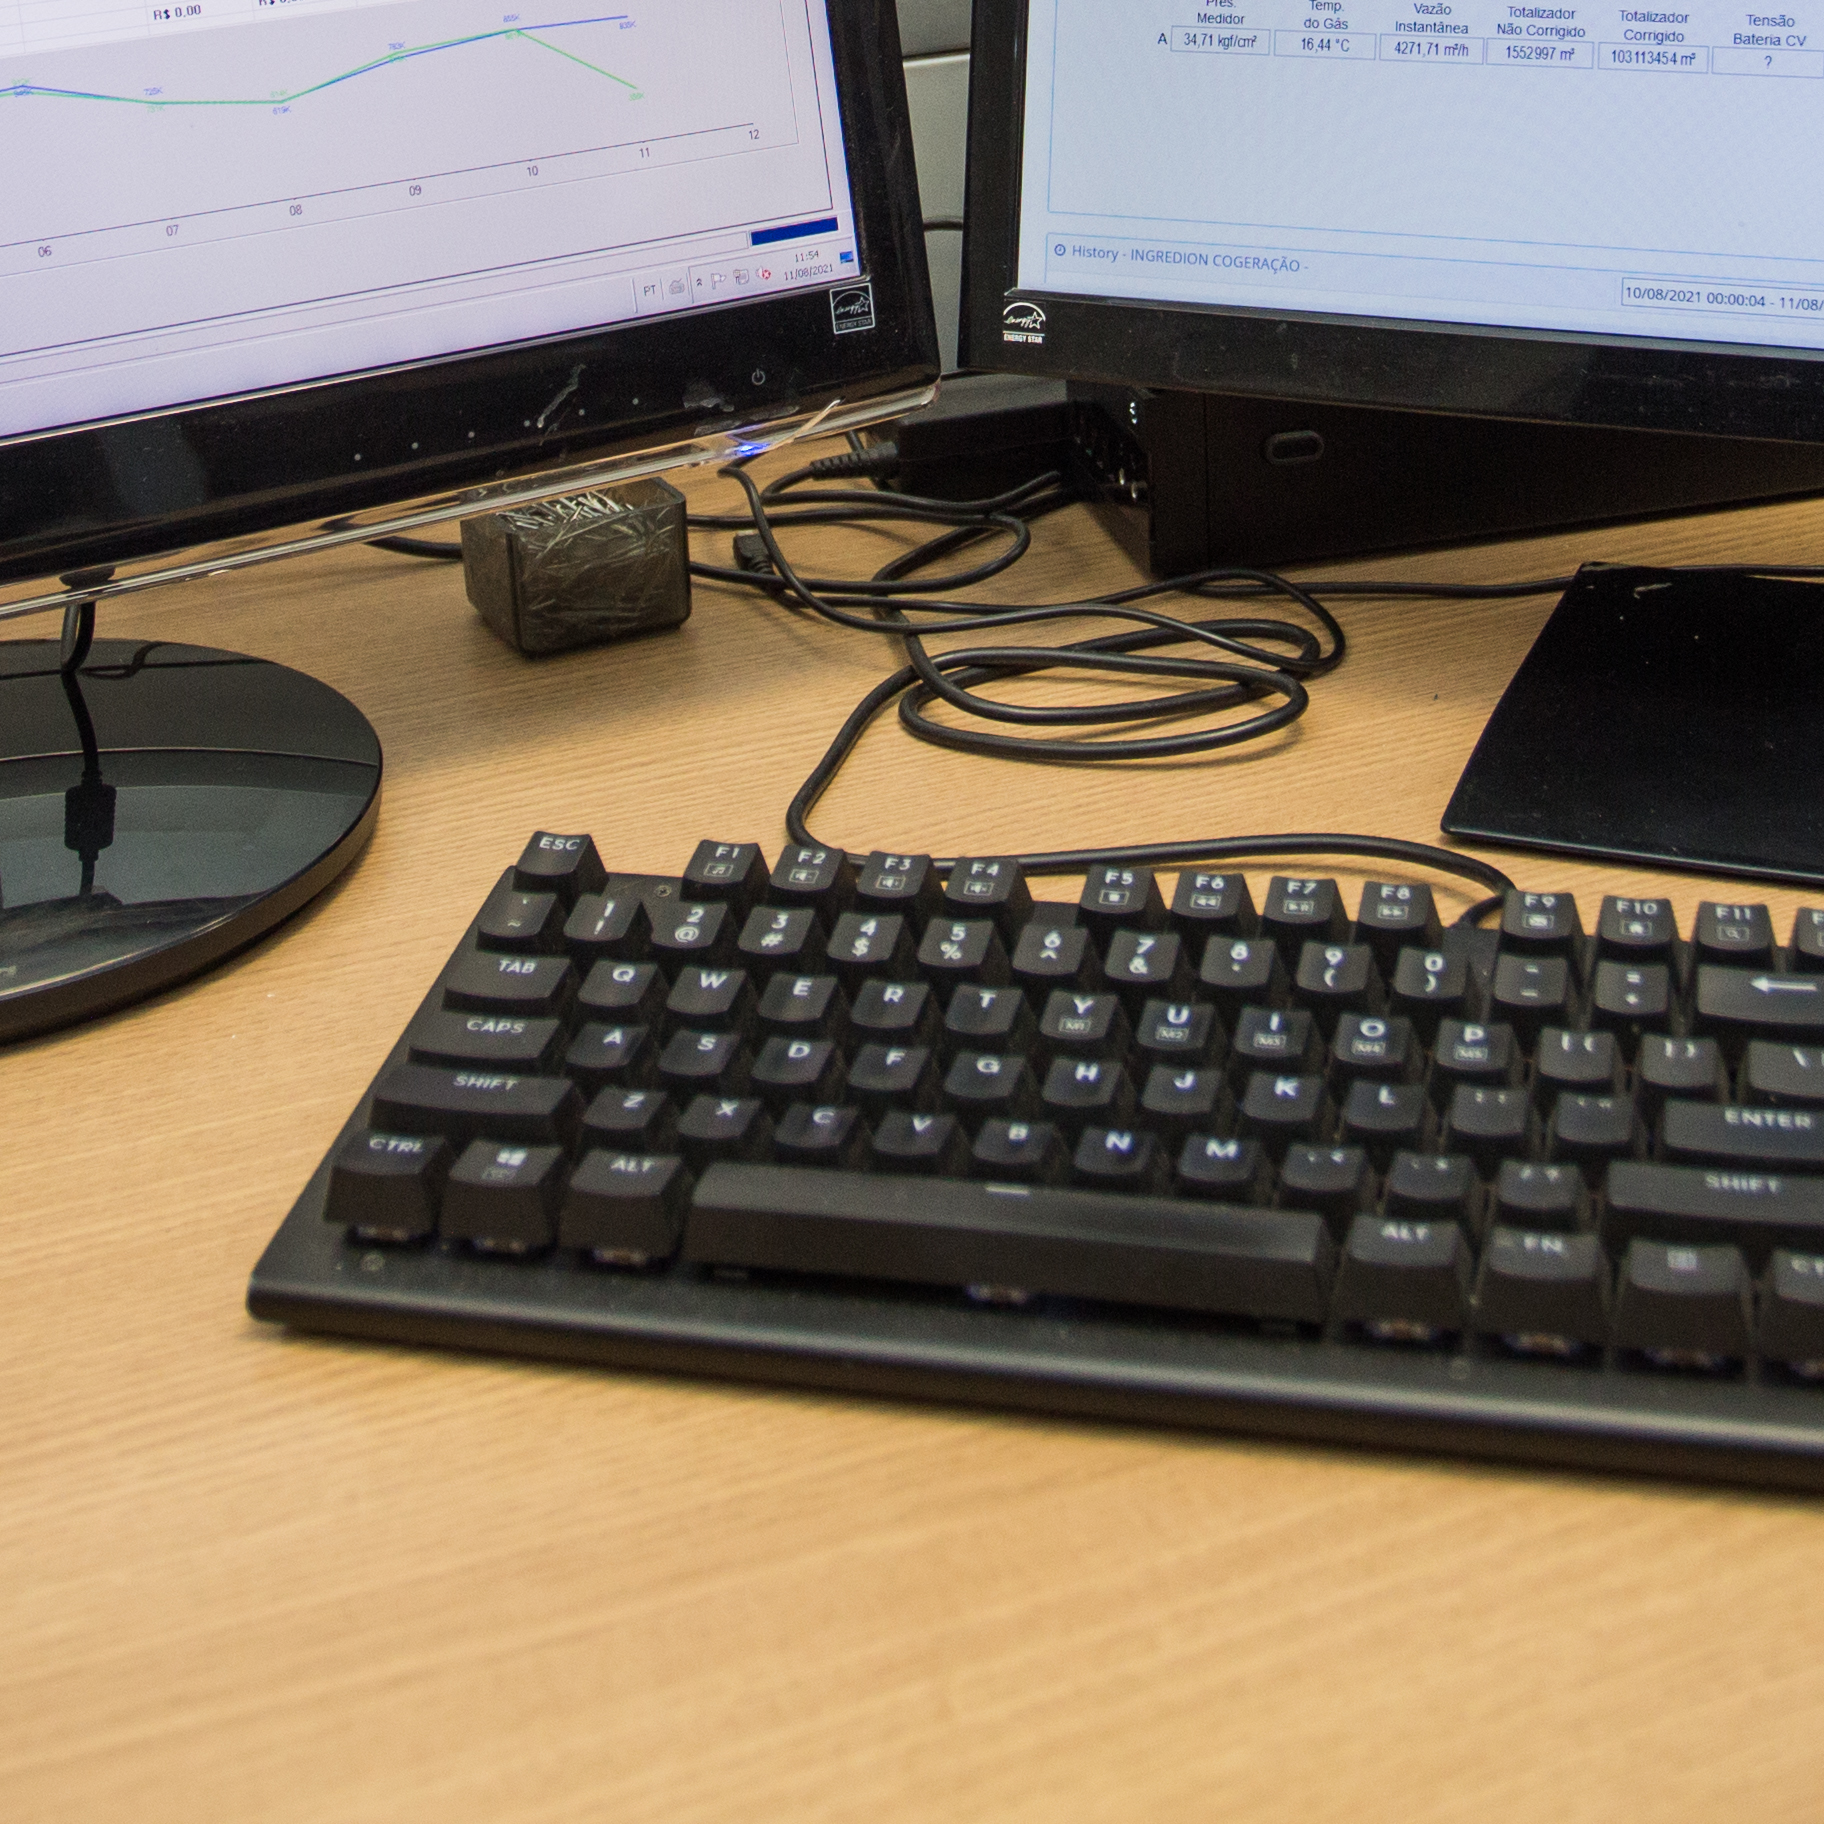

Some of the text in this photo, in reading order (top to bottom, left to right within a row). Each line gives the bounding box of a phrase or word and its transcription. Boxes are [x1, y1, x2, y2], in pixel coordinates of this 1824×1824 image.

[1309, 0, 1344, 14] Temp.
[1414, 2, 1451, 16] Vazão
[1507, 6, 1576, 20] Totalizador
[1197, 11, 1245, 25] Medidor
[1304, 16, 1348, 30] do Gás
[1395, 20, 1469, 34] Instantânea
[1497, 23, 1586, 40] Não Corrigido
[1184, 33, 1214, 47] 34,71
[1301, 36, 1331, 52] 16,44
[1394, 41, 1440, 57] 4271,71
[1505, 45, 1556, 60] 1552997
[749, 129, 760, 140] 12
[527, 165, 539, 177] 10
[38, 245, 52, 258] 06
[795, 251, 819, 262] 11:54
[1072, 242, 1300, 274] History INGREDION COGERAÇÃO
[784, 264, 833, 281] 11/08/2021
[1625, 285, 1703, 305] 10/08/2021
[1707, 292, 1767, 309] 00:00:04
[539, 836, 580, 850] ESC
[715, 846, 739, 858] F1
[798, 850, 826, 864] F2
[1105, 870, 1134, 887] F5
[498, 959, 538, 974] TAB
[700, 972, 727, 989] W
[467, 1019, 525, 1034] CAPS
[454, 1075, 518, 1090] SHIFT
[1724, 1109, 1814, 1130] ENTER
